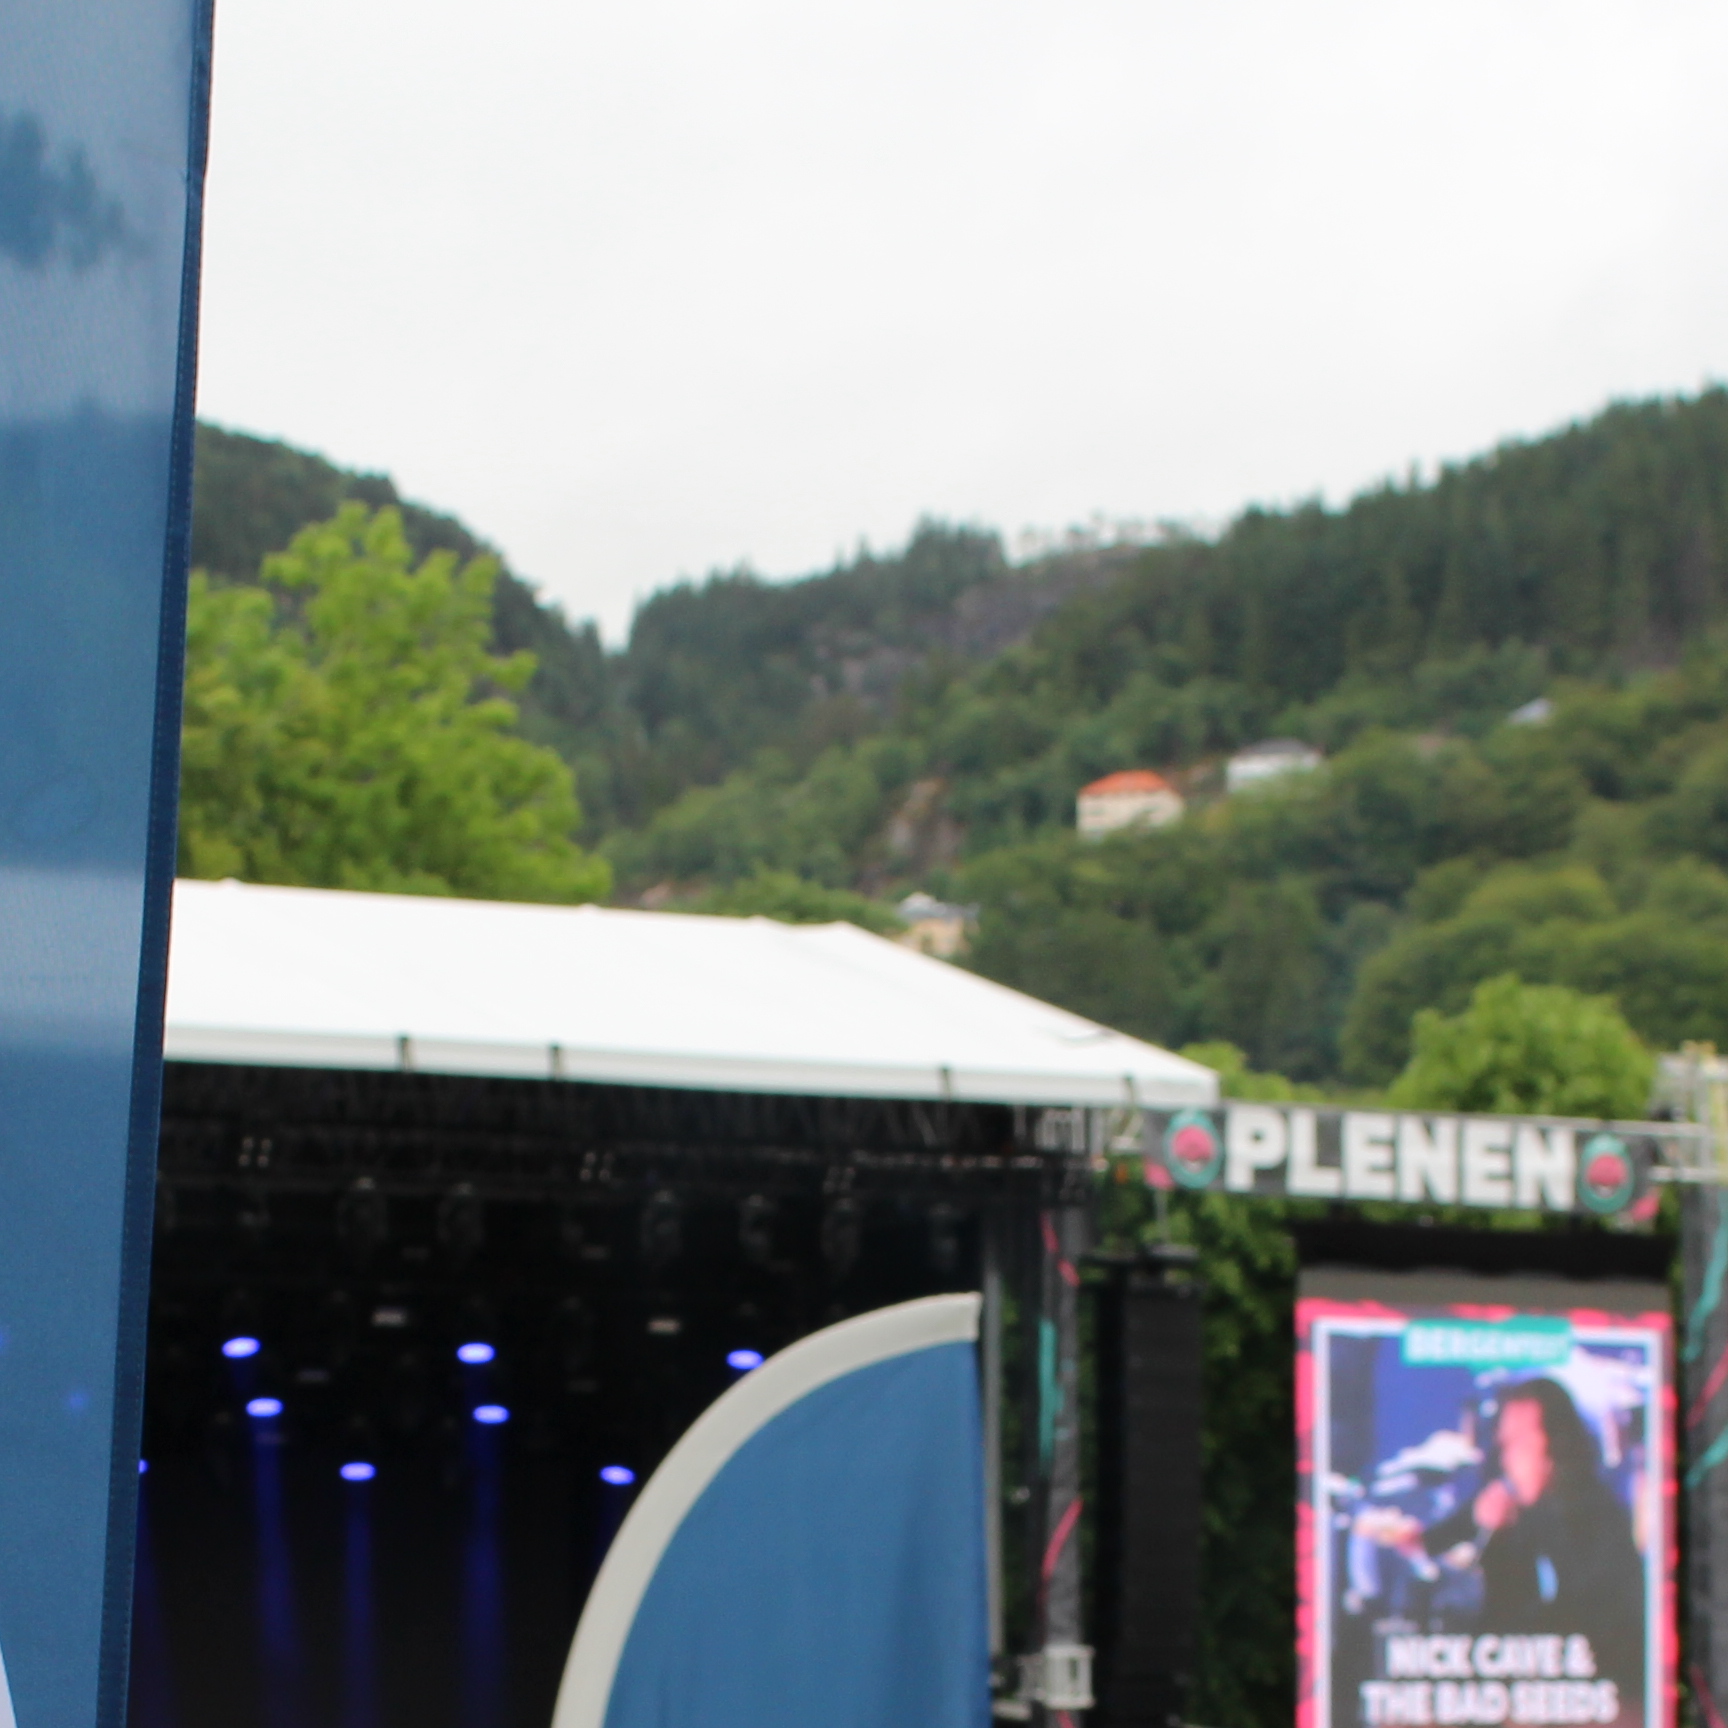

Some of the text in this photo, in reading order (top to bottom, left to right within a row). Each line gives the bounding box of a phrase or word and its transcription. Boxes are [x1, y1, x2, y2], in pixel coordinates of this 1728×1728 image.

[1225, 1104, 1575, 1211] PLENEN
[1386, 1633, 1472, 1679] NICK
[1474, 1633, 1564, 1679] CAVE
[1359, 1679, 1620, 1725] THE BAD SEEDS
